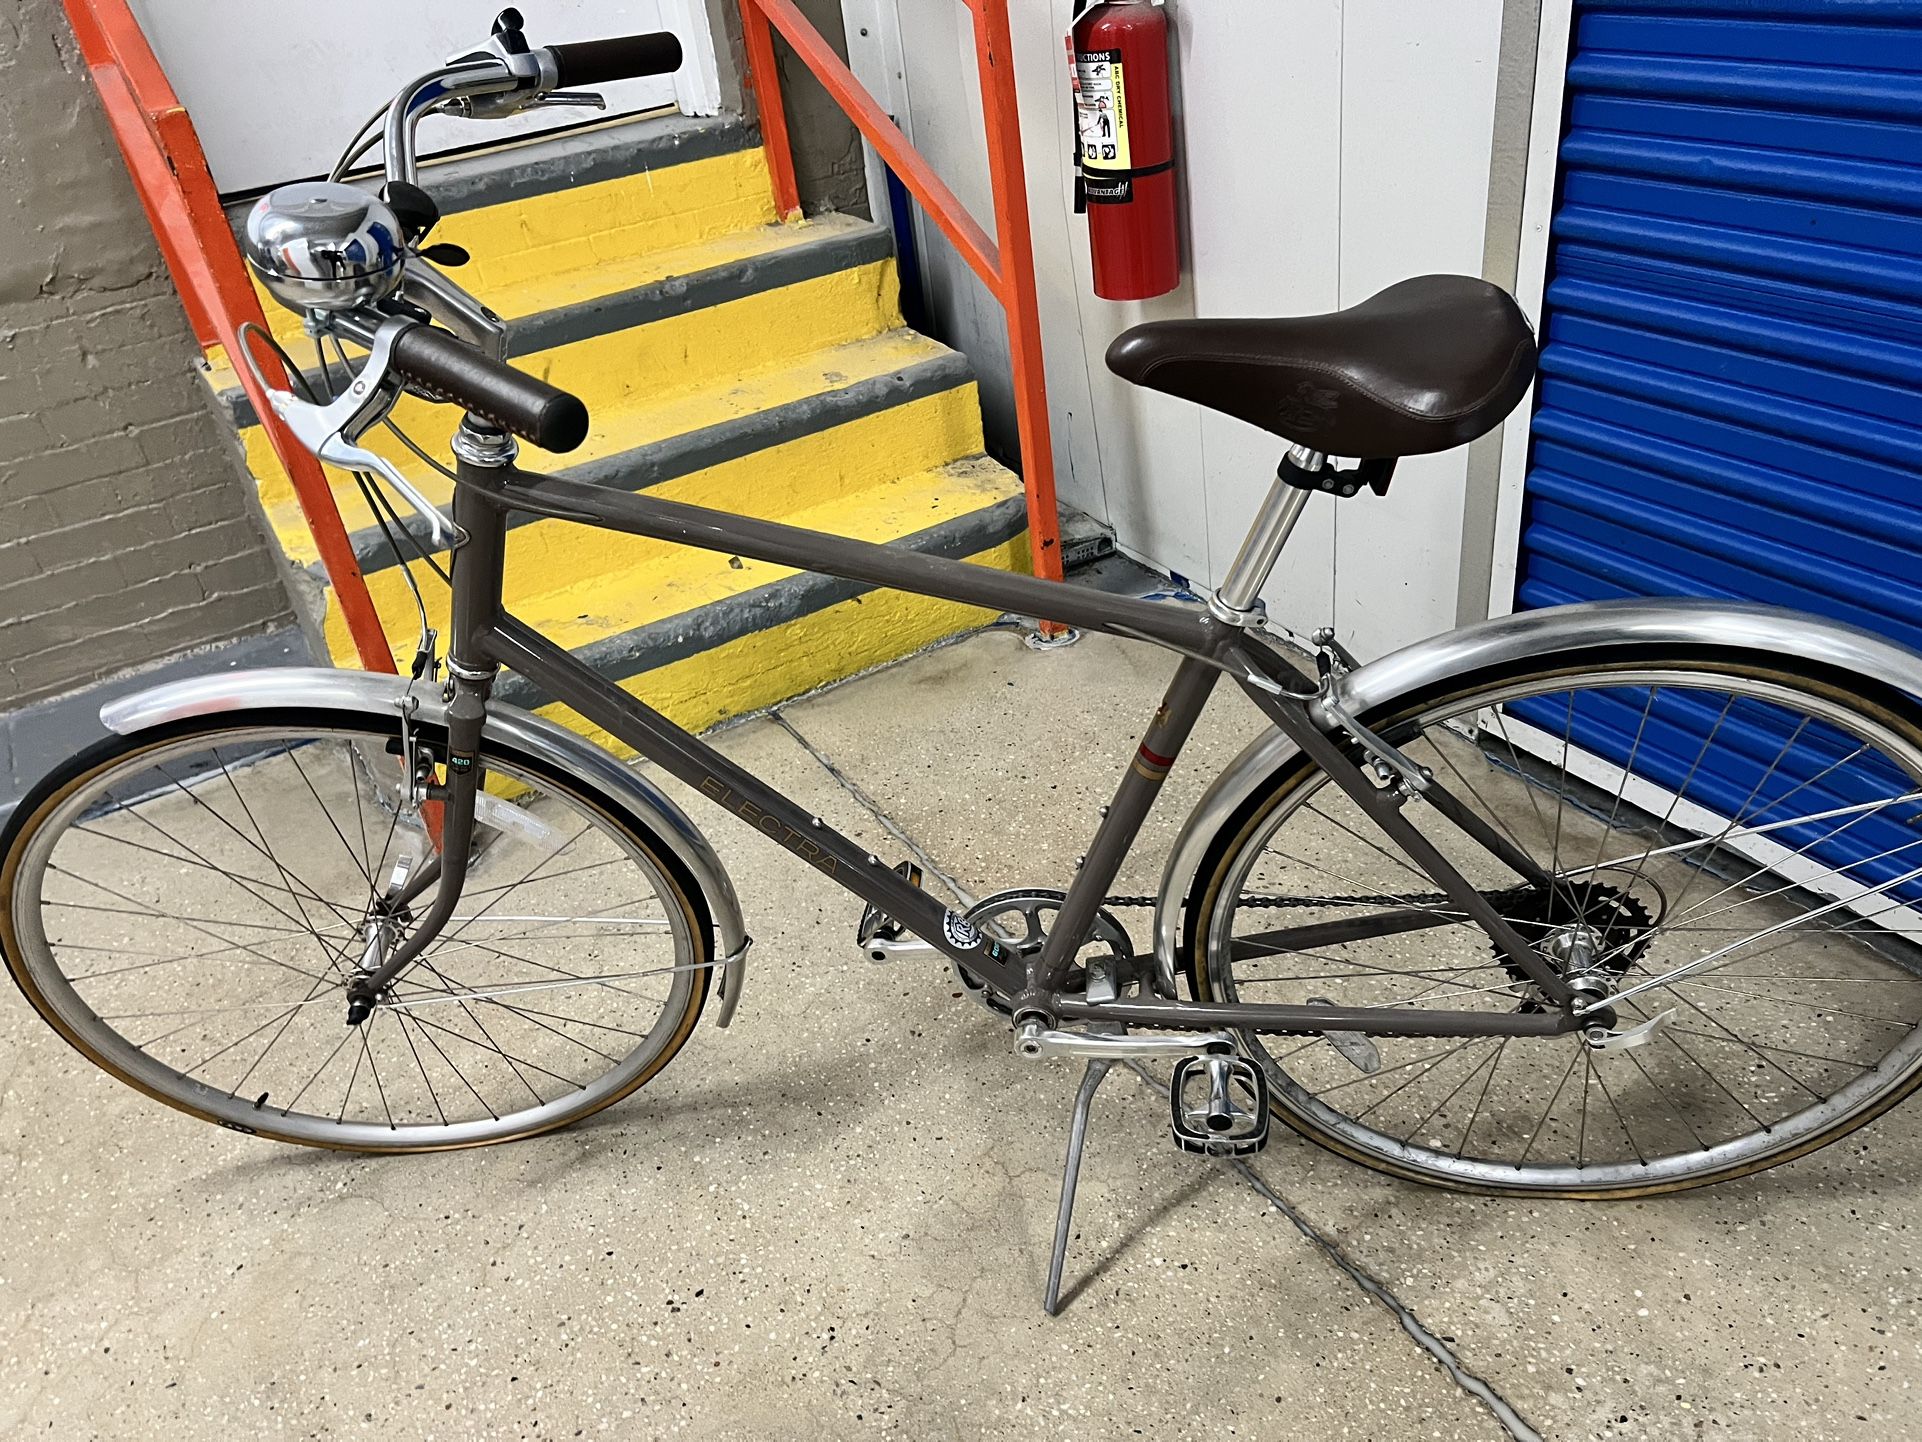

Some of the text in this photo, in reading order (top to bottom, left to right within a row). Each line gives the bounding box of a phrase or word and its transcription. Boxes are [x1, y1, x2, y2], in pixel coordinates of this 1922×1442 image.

[1116, 95, 1124, 128] CHEMICAL
[451, 757, 470, 766] 420
[699, 776, 838, 874] ELECTRA
